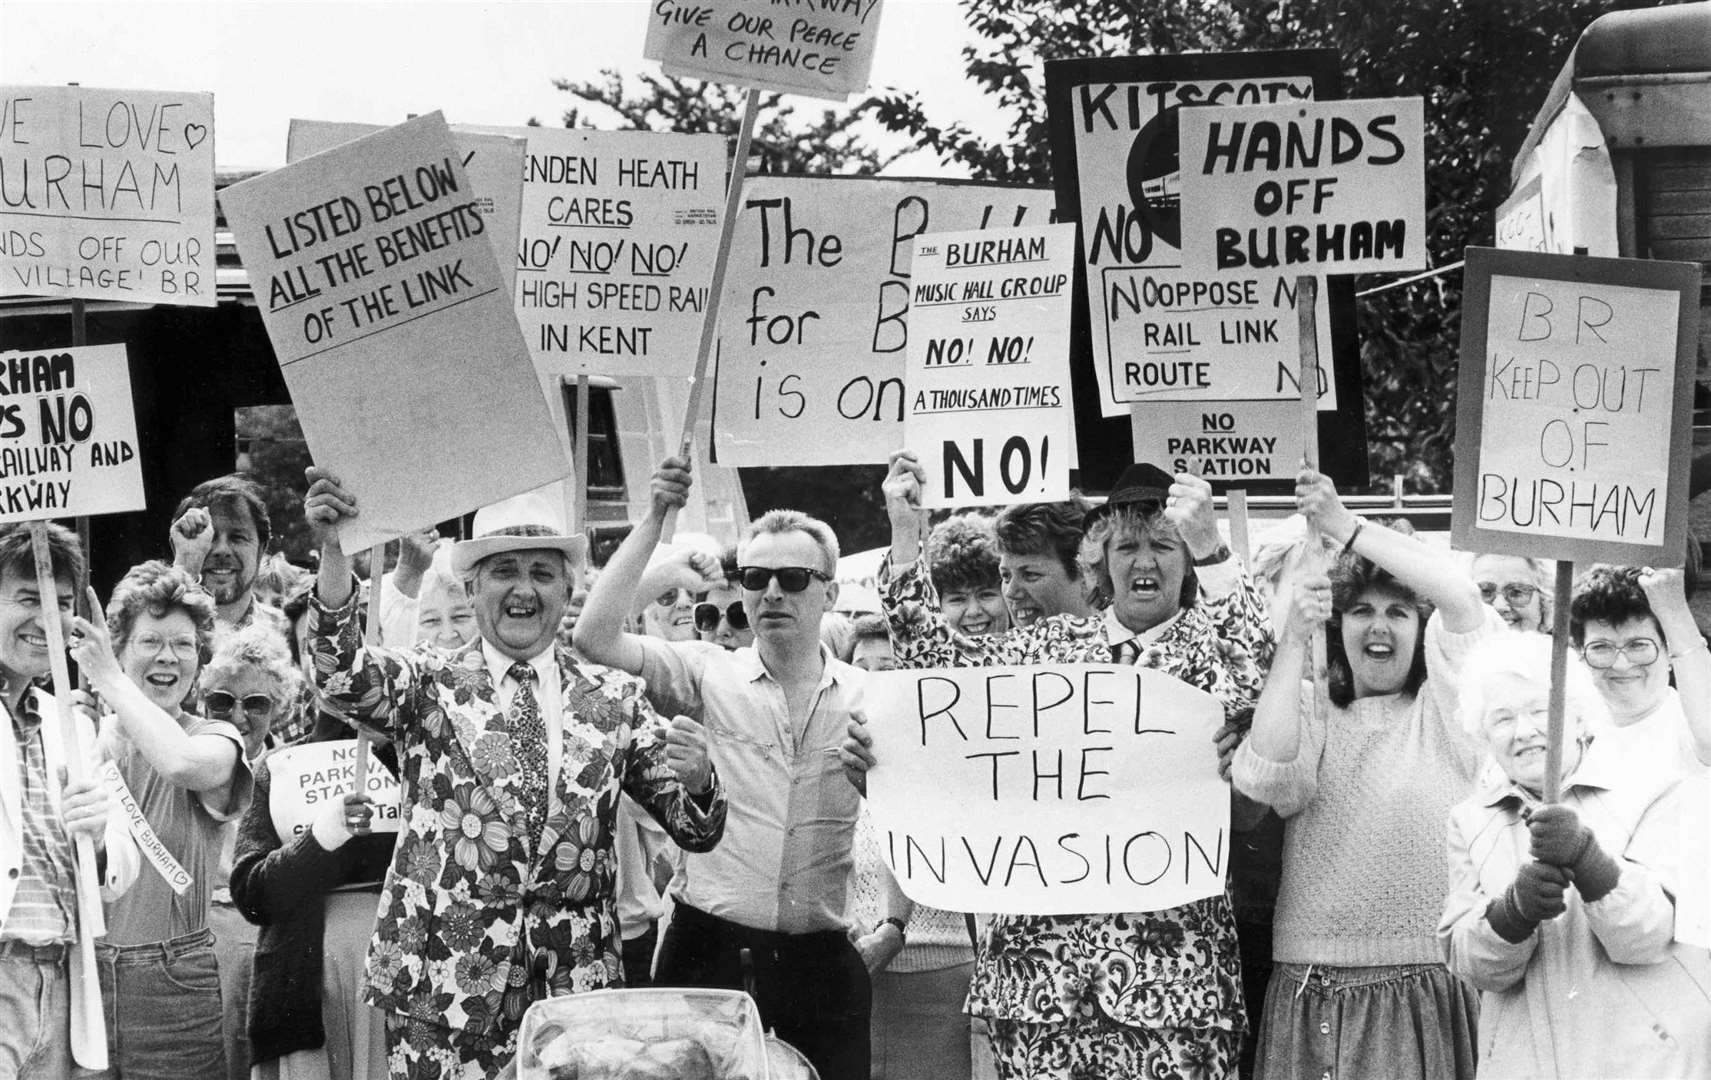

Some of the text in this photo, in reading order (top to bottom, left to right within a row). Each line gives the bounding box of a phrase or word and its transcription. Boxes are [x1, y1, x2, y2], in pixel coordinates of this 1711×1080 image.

[656, 0, 860, 51] GIVE OUR PEACE
[691, 33, 840, 75] A CHANCE
[0, 98, 183, 154] E LOVE
[1202, 114, 1405, 175] HANDS
[0, 155, 181, 213] URHAM
[618, 158, 698, 190] HEATH
[265, 158, 458, 259] LISTED BELOW
[548, 196, 634, 226] CARES
[1254, 177, 1338, 217] OFF
[78, 236, 127, 262] OFF
[140, 237, 200, 266] OUR
[746, 197, 842, 267] The
[921, 237, 1046, 266] THE BURHAM
[1089, 204, 1152, 265] NO
[1216, 219, 1406, 270] BURHAM
[270, 202, 485, 308] ALL THE BENEFITS
[570, 239, 625, 272] NO!
[631, 242, 688, 274] NO!
[304, 259, 474, 343] OF THE LINK
[522, 280, 577, 309] HIGH
[587, 282, 661, 311] SPEED
[915, 273, 1067, 303] MUSIC HALL GROUP
[1158, 280, 1259, 306] OPPOSE
[746, 286, 820, 345] for
[962, 306, 996, 321] SAYS
[1144, 319, 1278, 346] RAIL LINK
[541, 323, 652, 355] IN KENT
[925, 336, 1034, 365] NO! NO!
[755, 360, 906, 421] is on
[1125, 362, 1211, 386] ROUTE
[1491, 353, 1660, 412] KEEP OUT
[0, 395, 93, 445] S NO
[913, 390, 926, 410] A
[1202, 413, 1235, 431] NO
[91, 441, 134, 467] AND
[1168, 437, 1277, 454] PARKWAY
[1541, 419, 1609, 470] OF
[943, 434, 1049, 499] NO!
[1173, 458, 1271, 475] SATION
[1480, 474, 1655, 538] BURHAM
[918, 671, 1176, 746] REPEL
[300, 762, 384, 788] PARKW
[305, 776, 398, 804] STATON
[965, 747, 1113, 801] THE
[121, 796, 145, 828] LOVE
[140, 829, 177, 874] BURHAM
[888, 828, 1223, 887] INVASION
